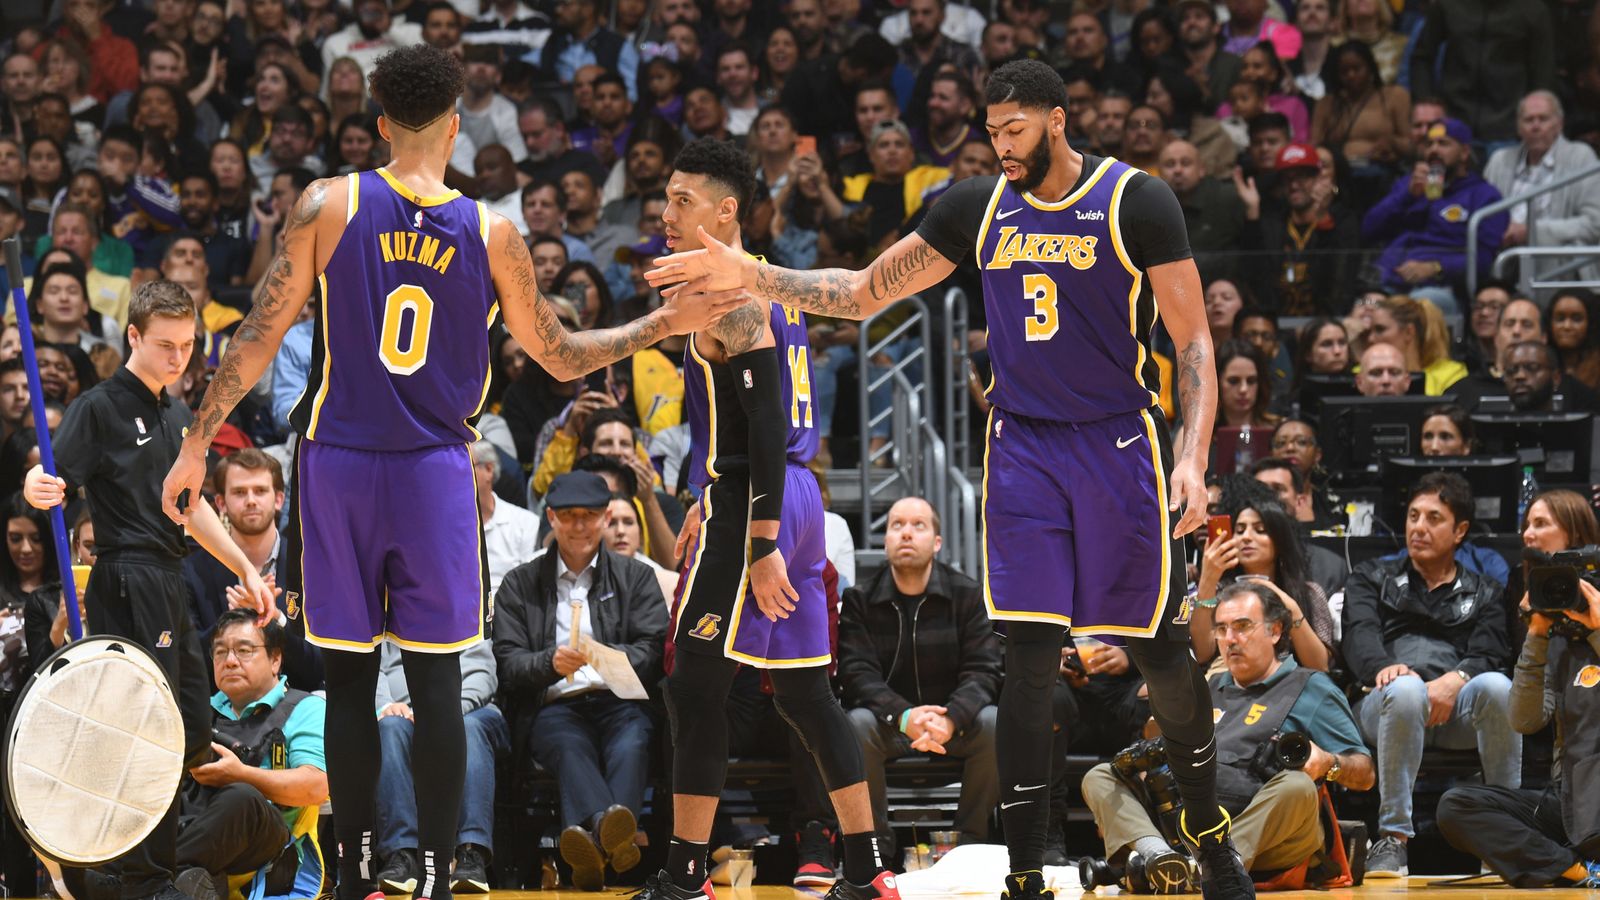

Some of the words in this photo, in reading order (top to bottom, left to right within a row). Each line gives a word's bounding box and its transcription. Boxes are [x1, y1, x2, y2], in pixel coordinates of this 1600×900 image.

[1075, 210, 1104, 221] wish
[379, 231, 456, 275] KUZMA
[869, 241, 933, 301] Chicago
[986, 226, 1098, 270] LAKERS
[378, 283, 434, 376] 0
[1022, 273, 1059, 342] 3
[787, 344, 814, 428] 14
[1244, 703, 1267, 725] 5
